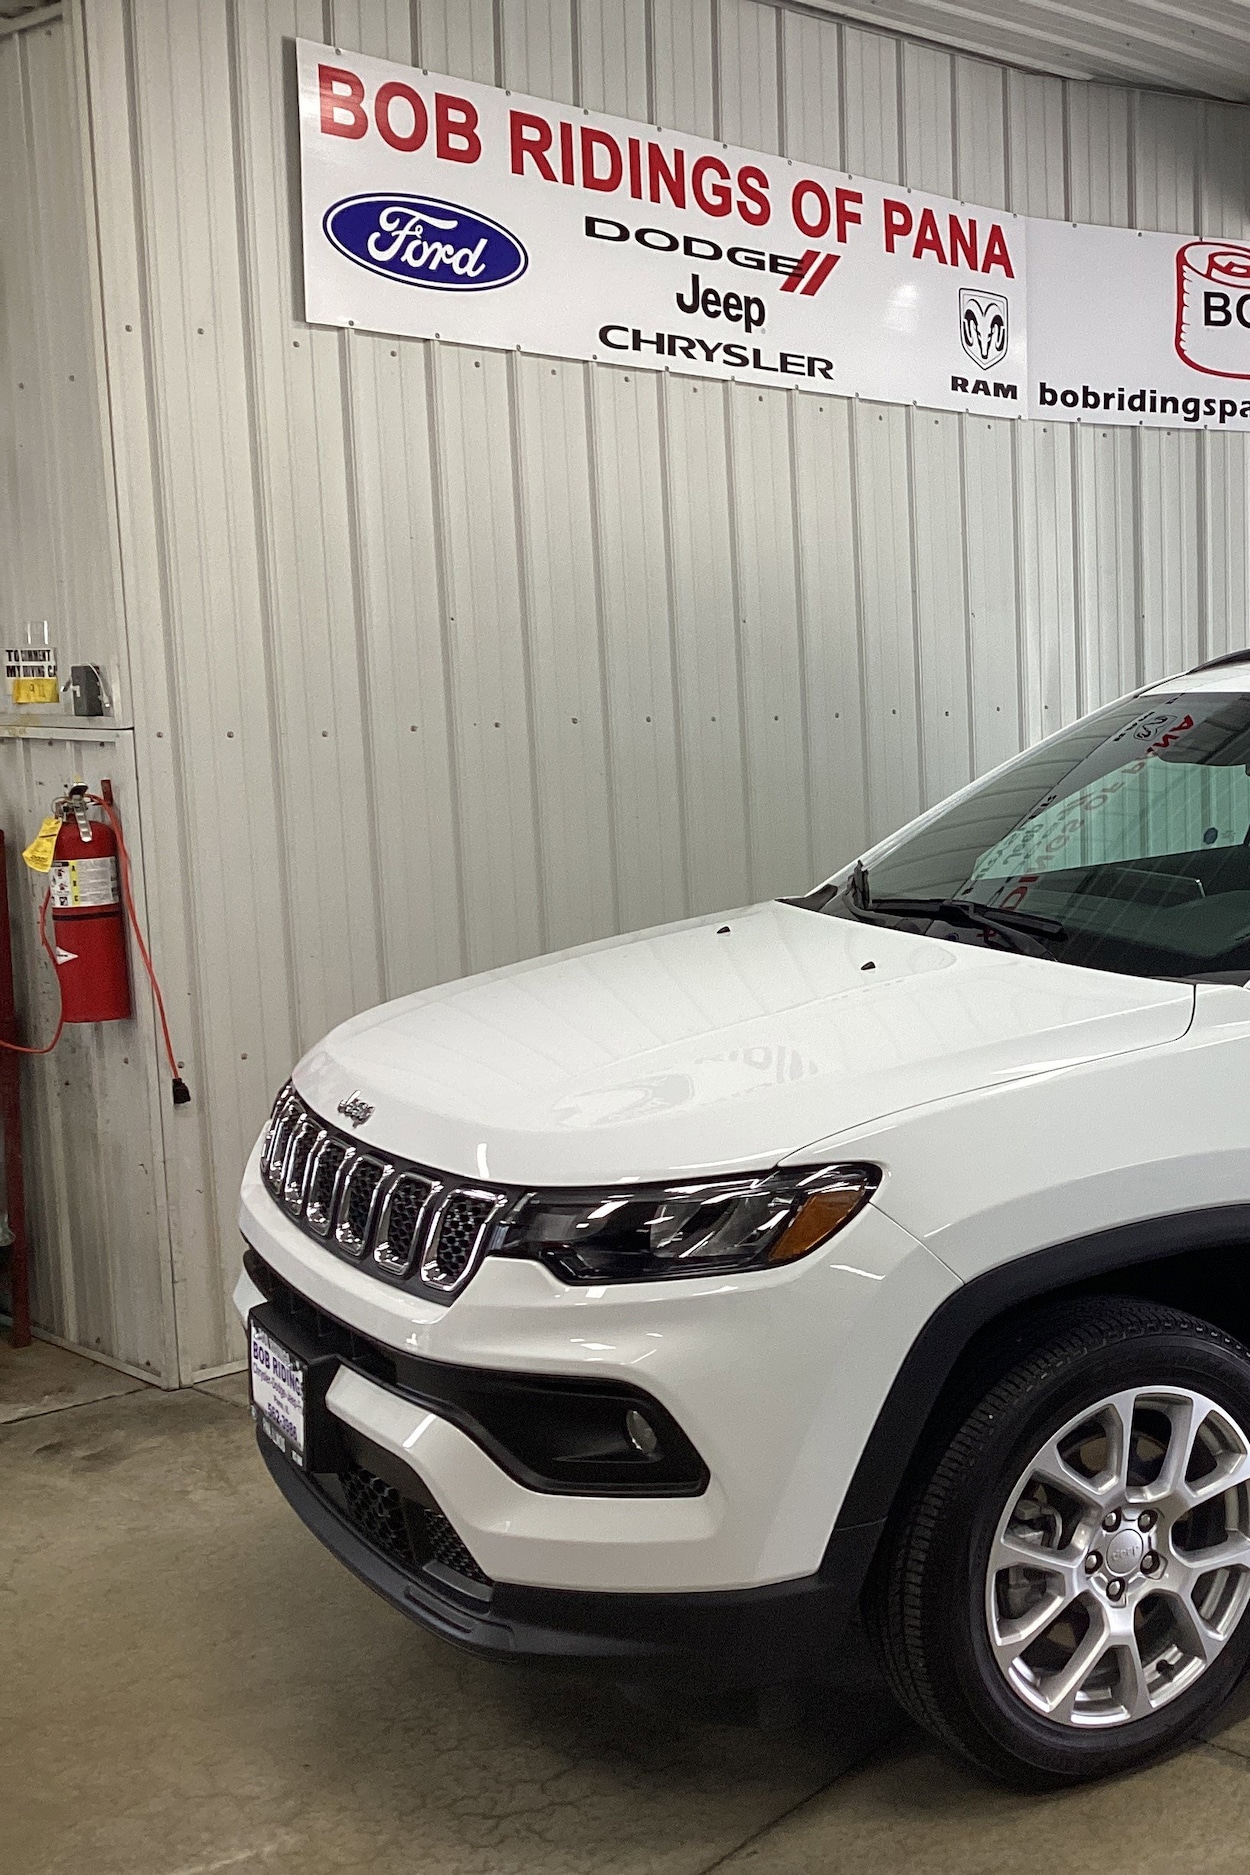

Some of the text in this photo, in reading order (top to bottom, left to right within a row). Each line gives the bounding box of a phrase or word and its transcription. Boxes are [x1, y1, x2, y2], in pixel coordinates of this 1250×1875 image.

[318, 65, 1015, 280] BOB RIDINGS OF PANA
[366, 206, 489, 278] Ford
[585, 215, 806, 279] DODGE
[676, 273, 766, 333] Jeep
[598, 325, 834, 381] CHRYSLER
[951, 375, 1018, 400] RAM
[253, 1341, 271, 1370] BOB
